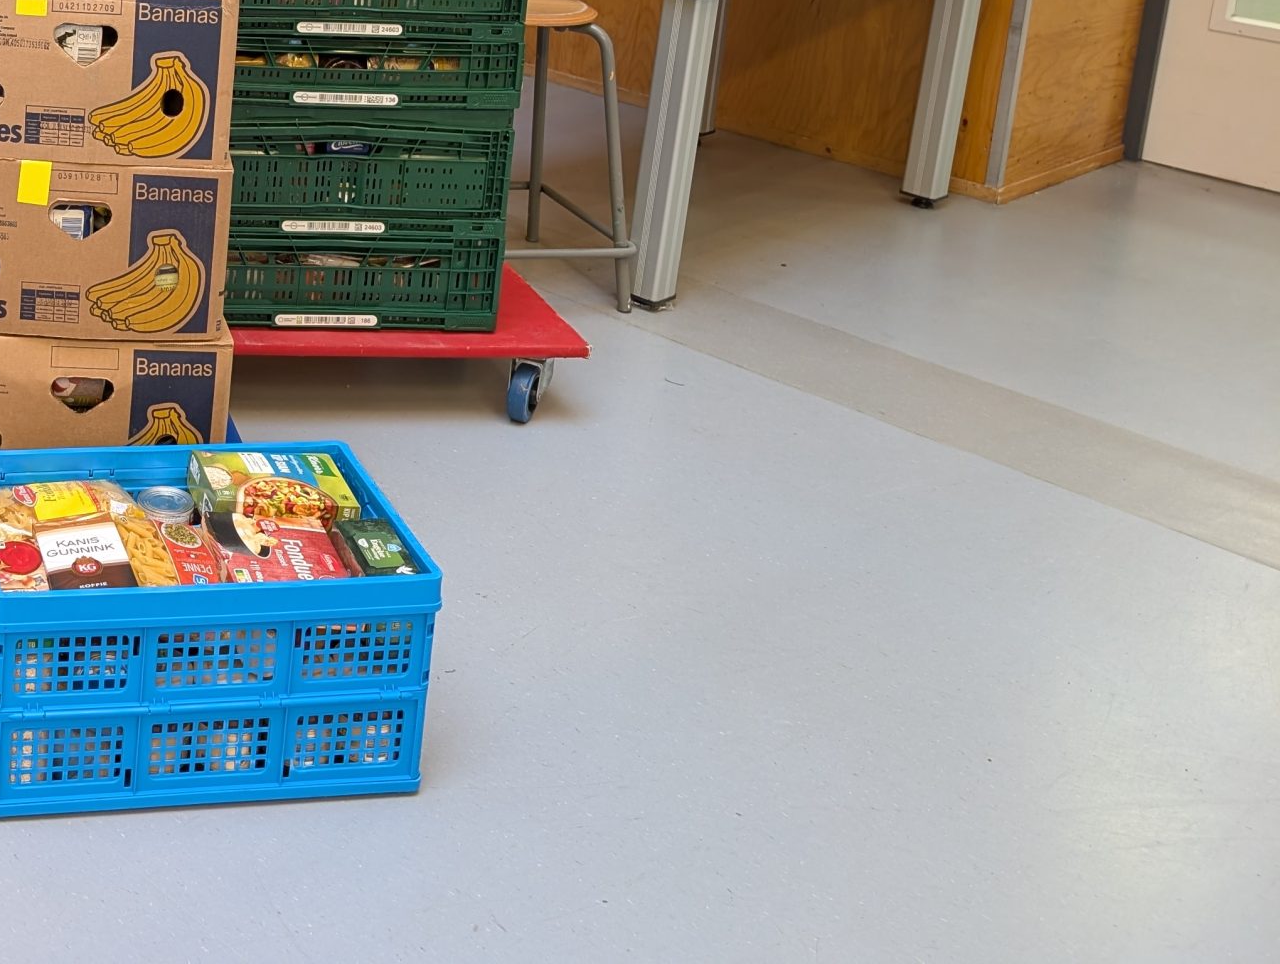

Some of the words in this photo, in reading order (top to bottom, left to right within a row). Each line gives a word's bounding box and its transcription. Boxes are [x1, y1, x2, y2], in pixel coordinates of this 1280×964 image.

[137, 2, 219, 24] Bananas
[135, 182, 214, 203] Bananas
[136, 358, 213, 377] Bananas
[56, 537, 99, 547] KANIS
[47, 544, 115, 557] GUNNINK
[78, 563, 97, 572] KG
[281, 539, 314, 580] Fondue
[182, 562, 213, 574] PENNE
